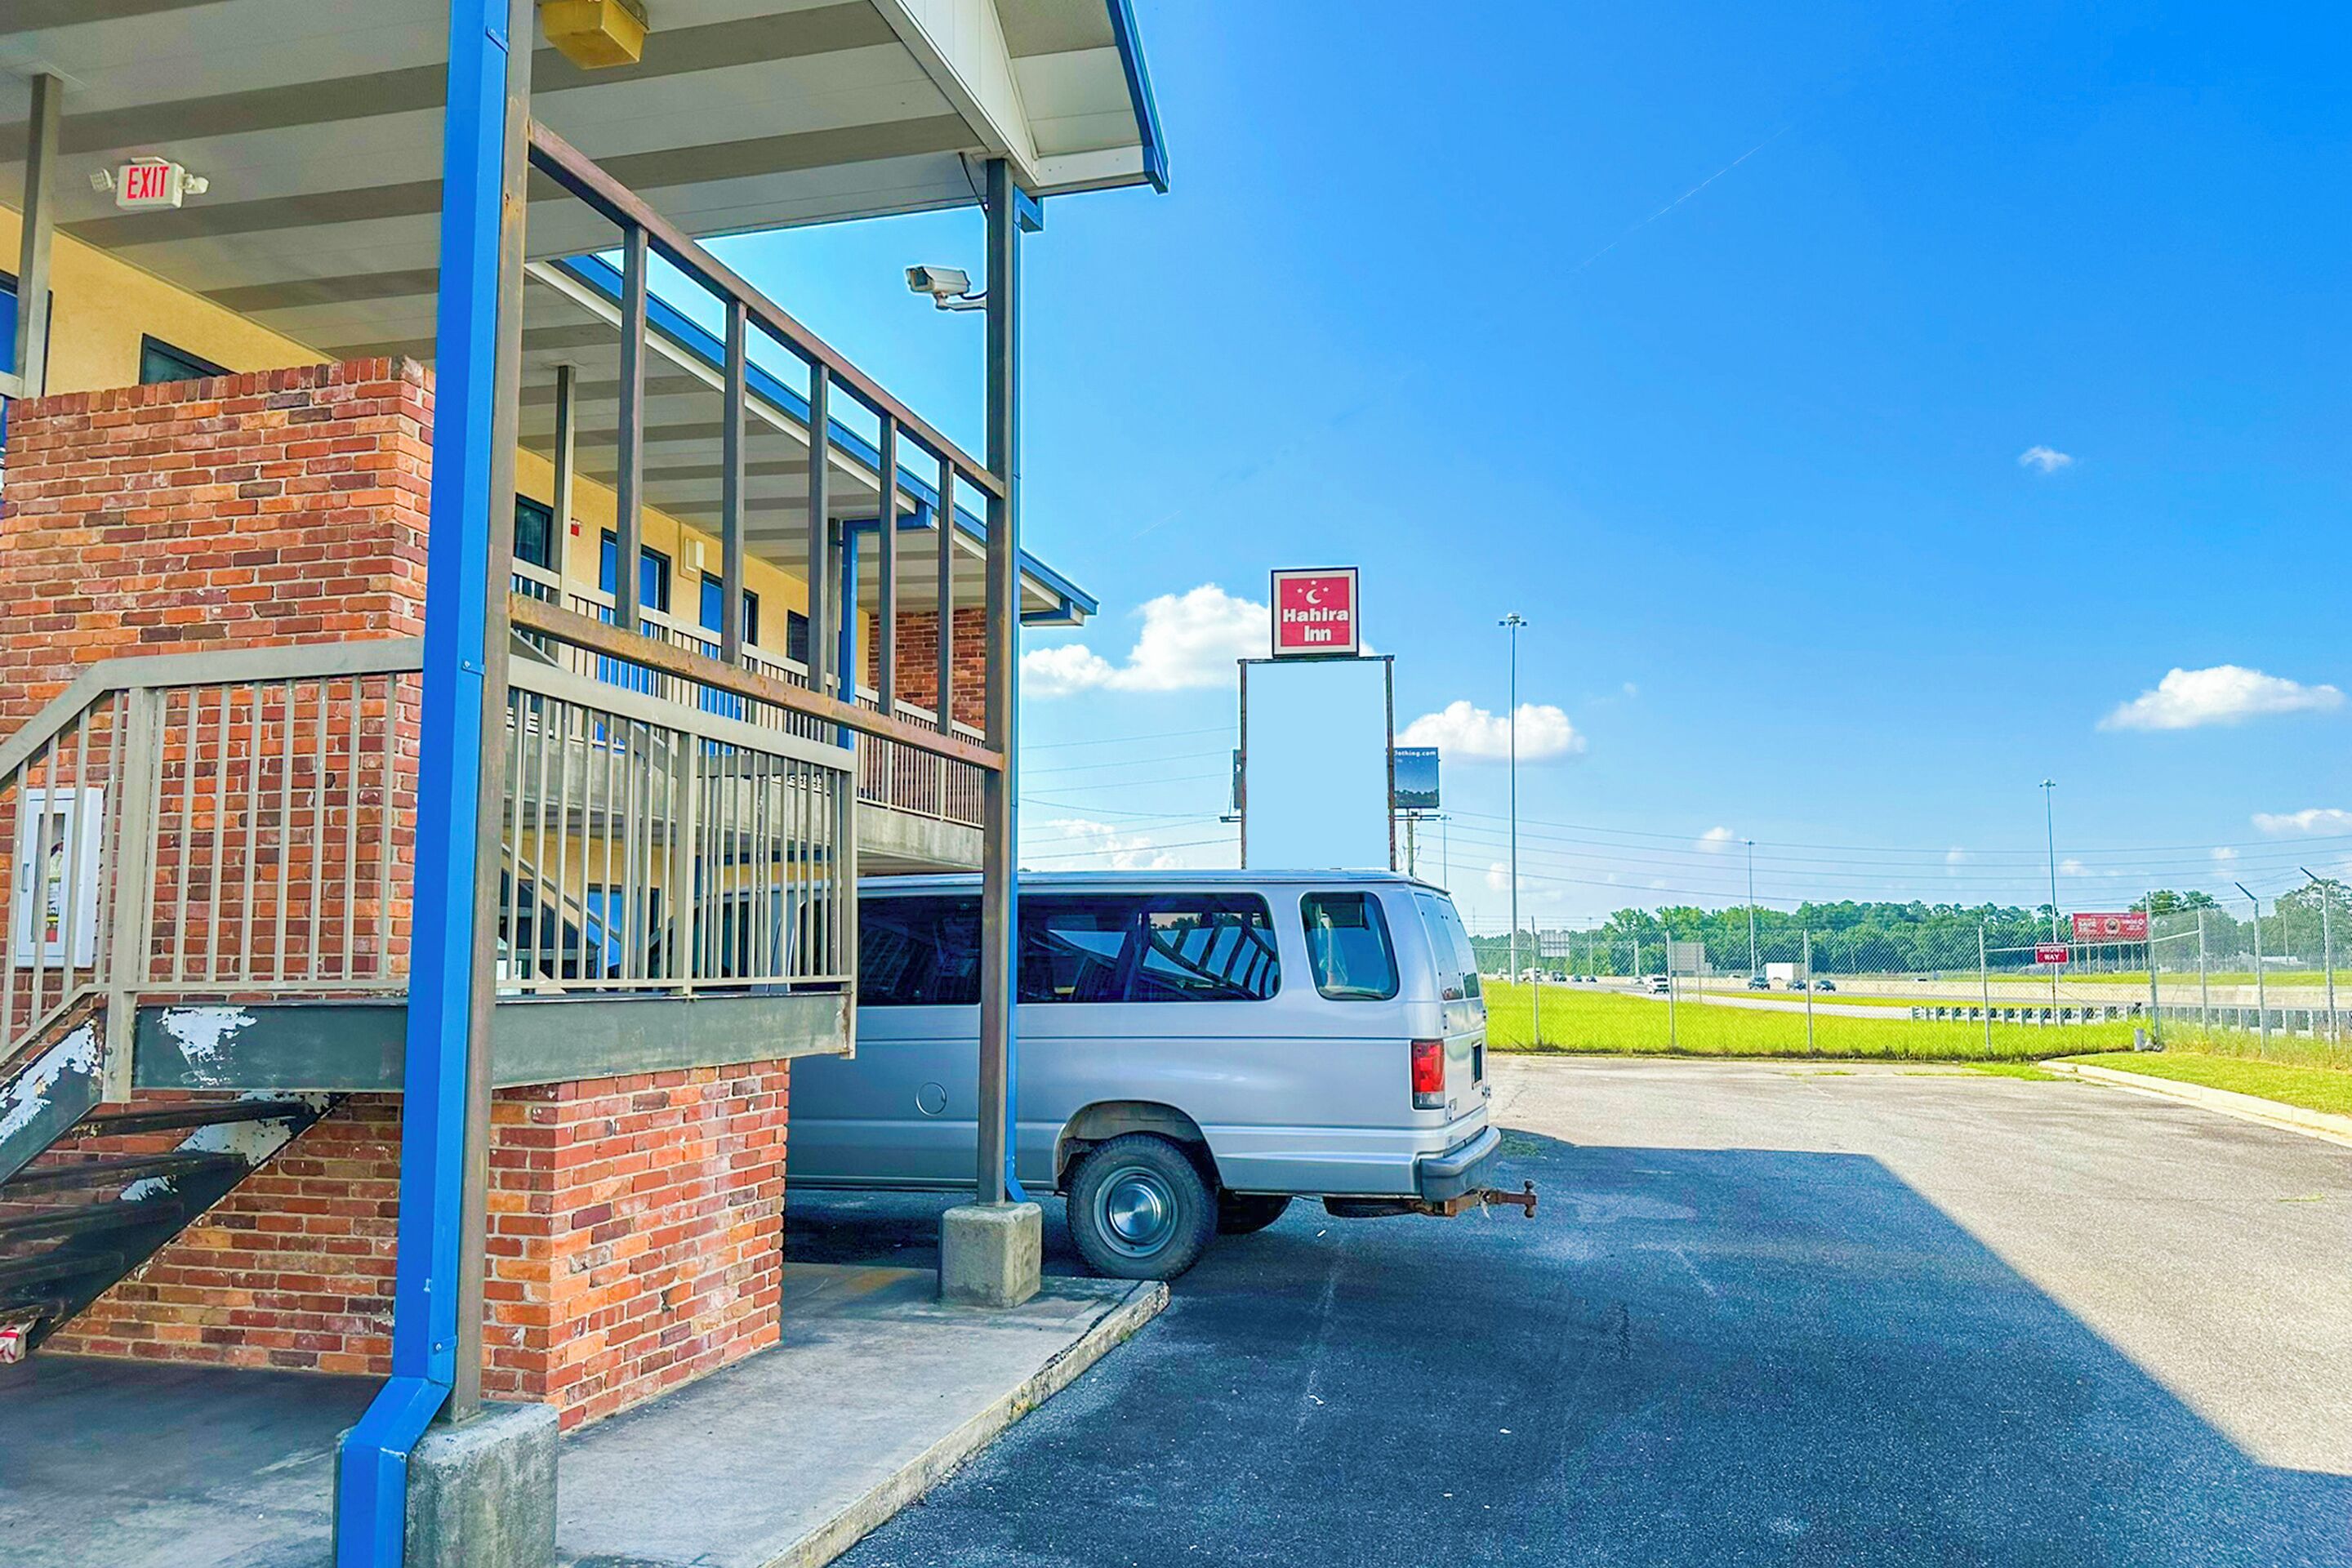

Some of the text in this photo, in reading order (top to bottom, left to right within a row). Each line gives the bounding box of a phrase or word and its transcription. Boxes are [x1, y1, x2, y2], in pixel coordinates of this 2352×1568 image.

[127, 166, 169, 198] EXIT
[1283, 607, 1348, 622] Hahira
[1304, 626, 1331, 641] Inn
